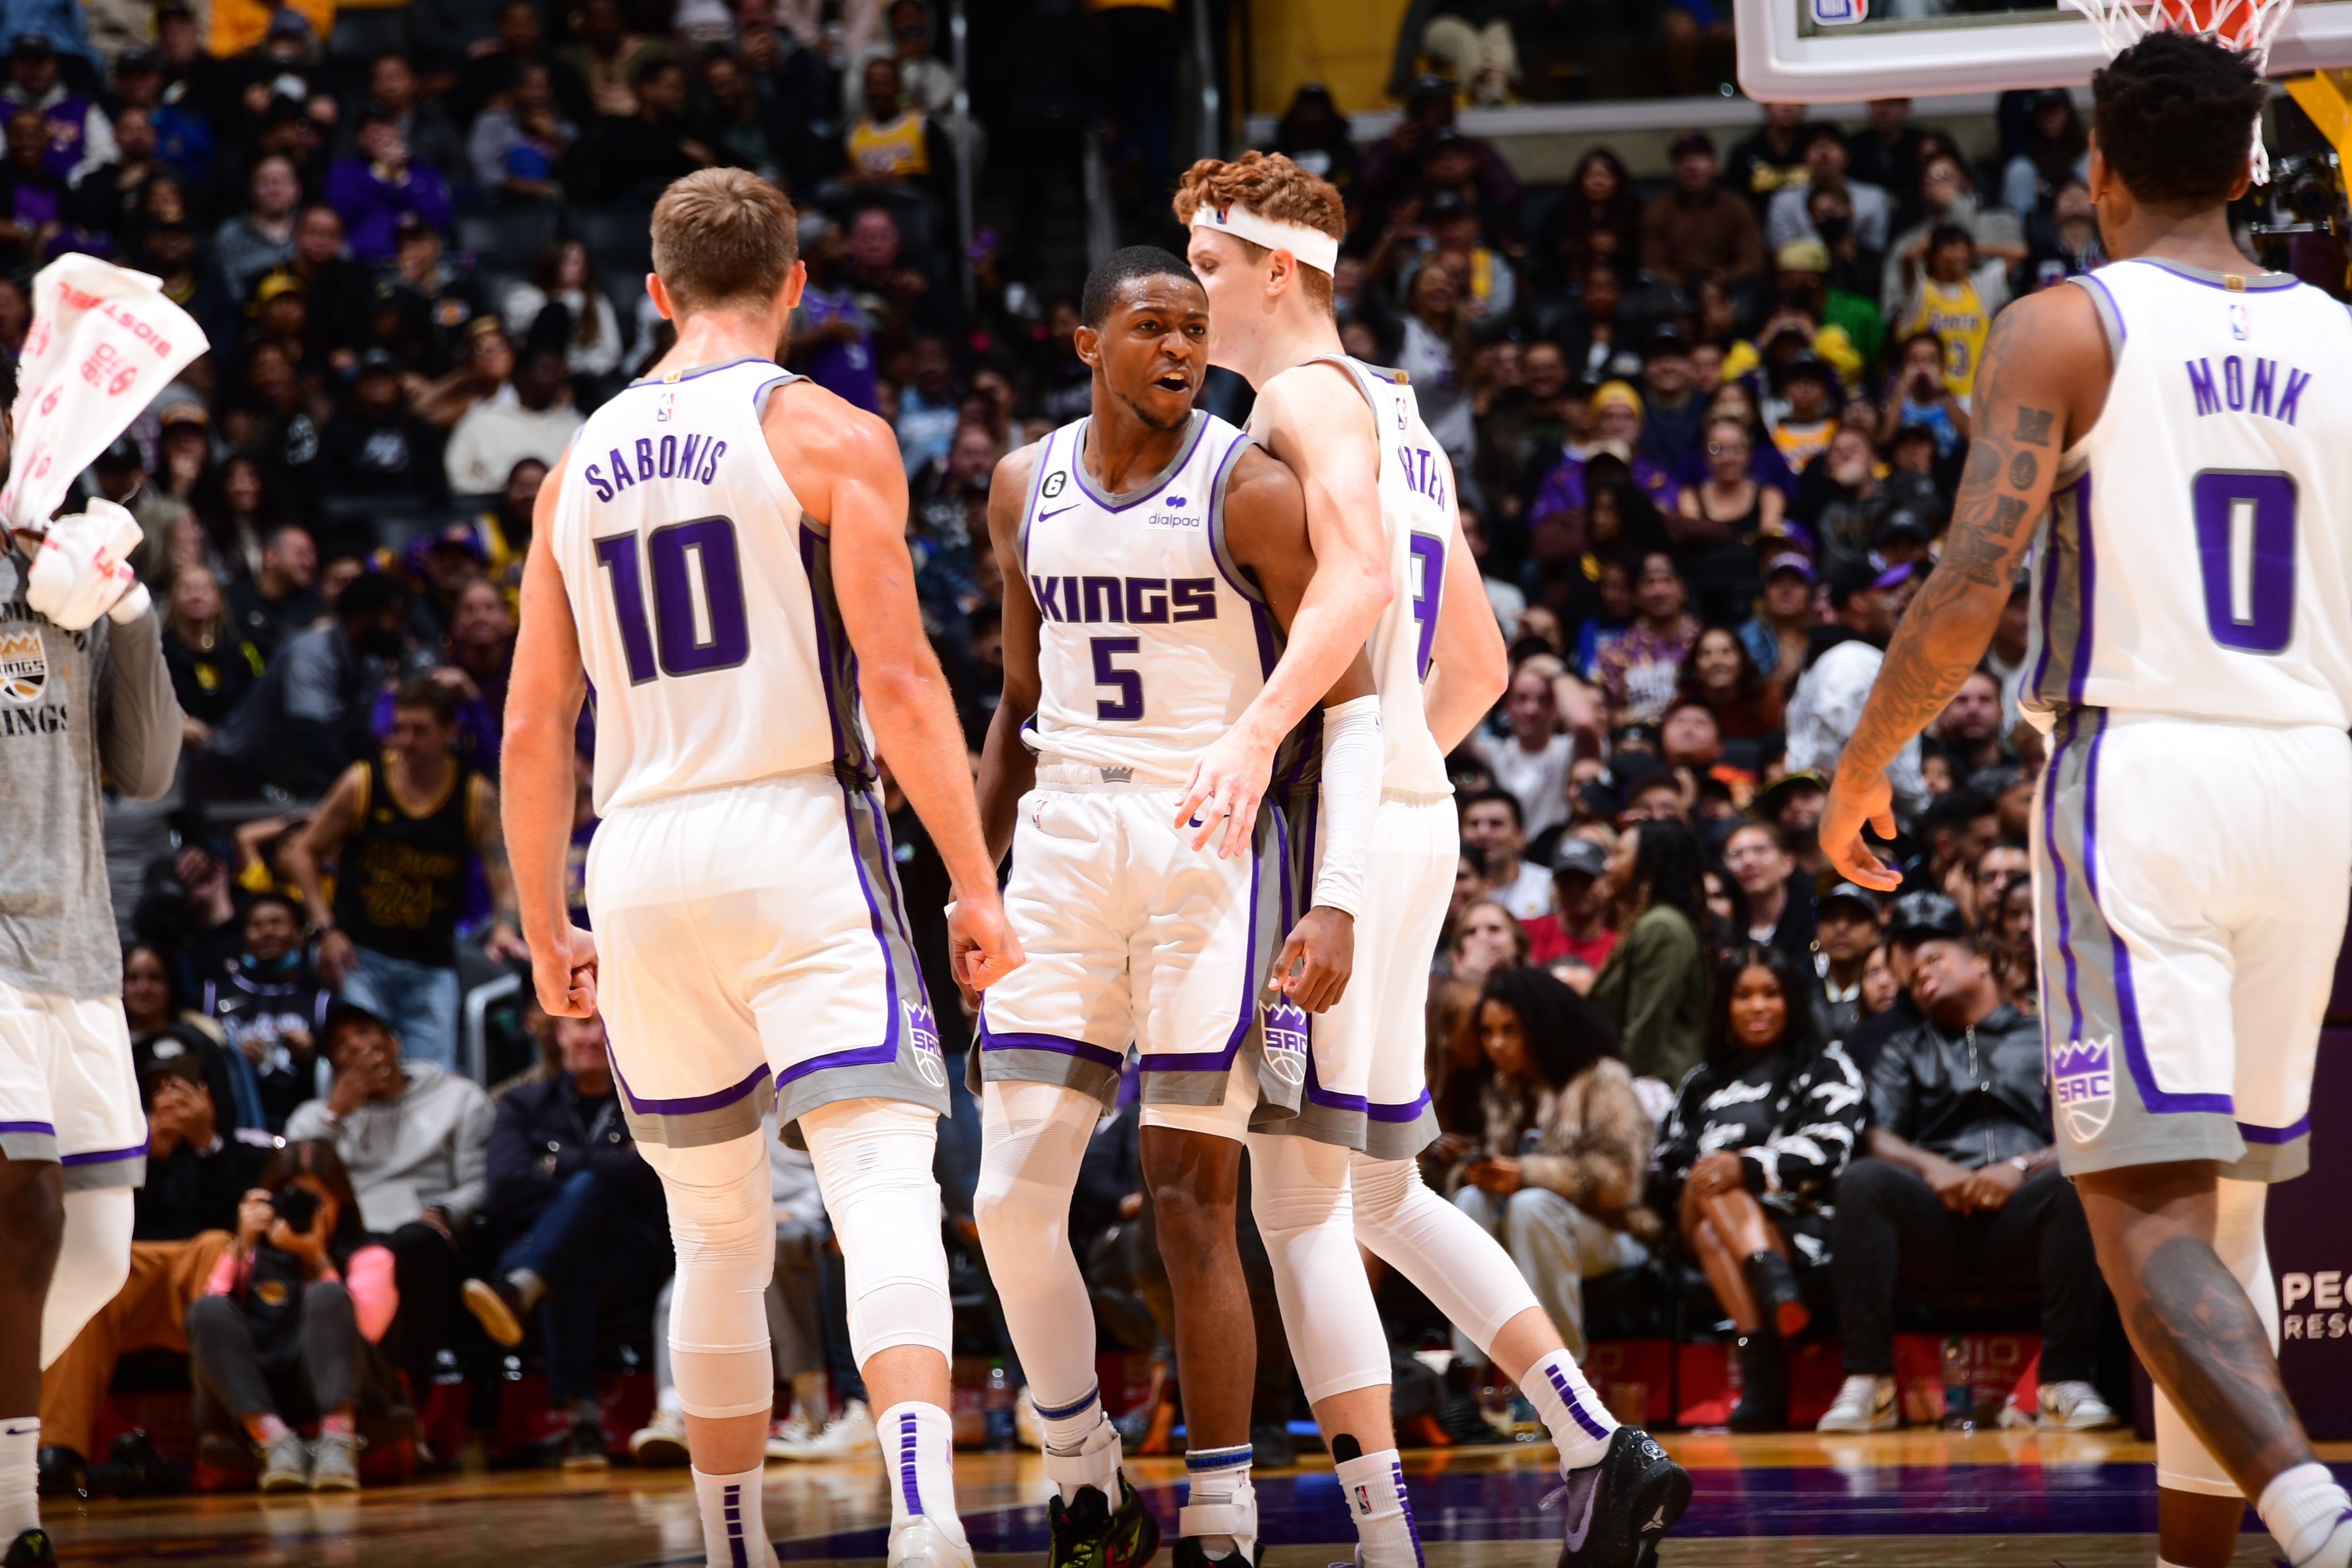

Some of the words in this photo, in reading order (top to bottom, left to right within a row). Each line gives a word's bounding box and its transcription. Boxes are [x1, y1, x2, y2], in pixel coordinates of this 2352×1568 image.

[2185, 355, 2312, 427] MONK
[585, 433, 728, 503] SABONIS
[1044, 472, 1065, 497] 6
[1148, 513, 1200, 528] dialpad
[2192, 468, 2299, 656] 0
[593, 514, 751, 688] 10
[1030, 575, 1218, 624] KINGS
[0, 660, 44, 677] INGS
[1089, 636, 1145, 722] 5
[0, 704, 67, 738] INGS
[1266, 1031, 1306, 1056] SAC
[2057, 1074, 2110, 1104] SAC
[2282, 1271, 2352, 1311] PE
[2284, 1313, 2352, 1341] RES
